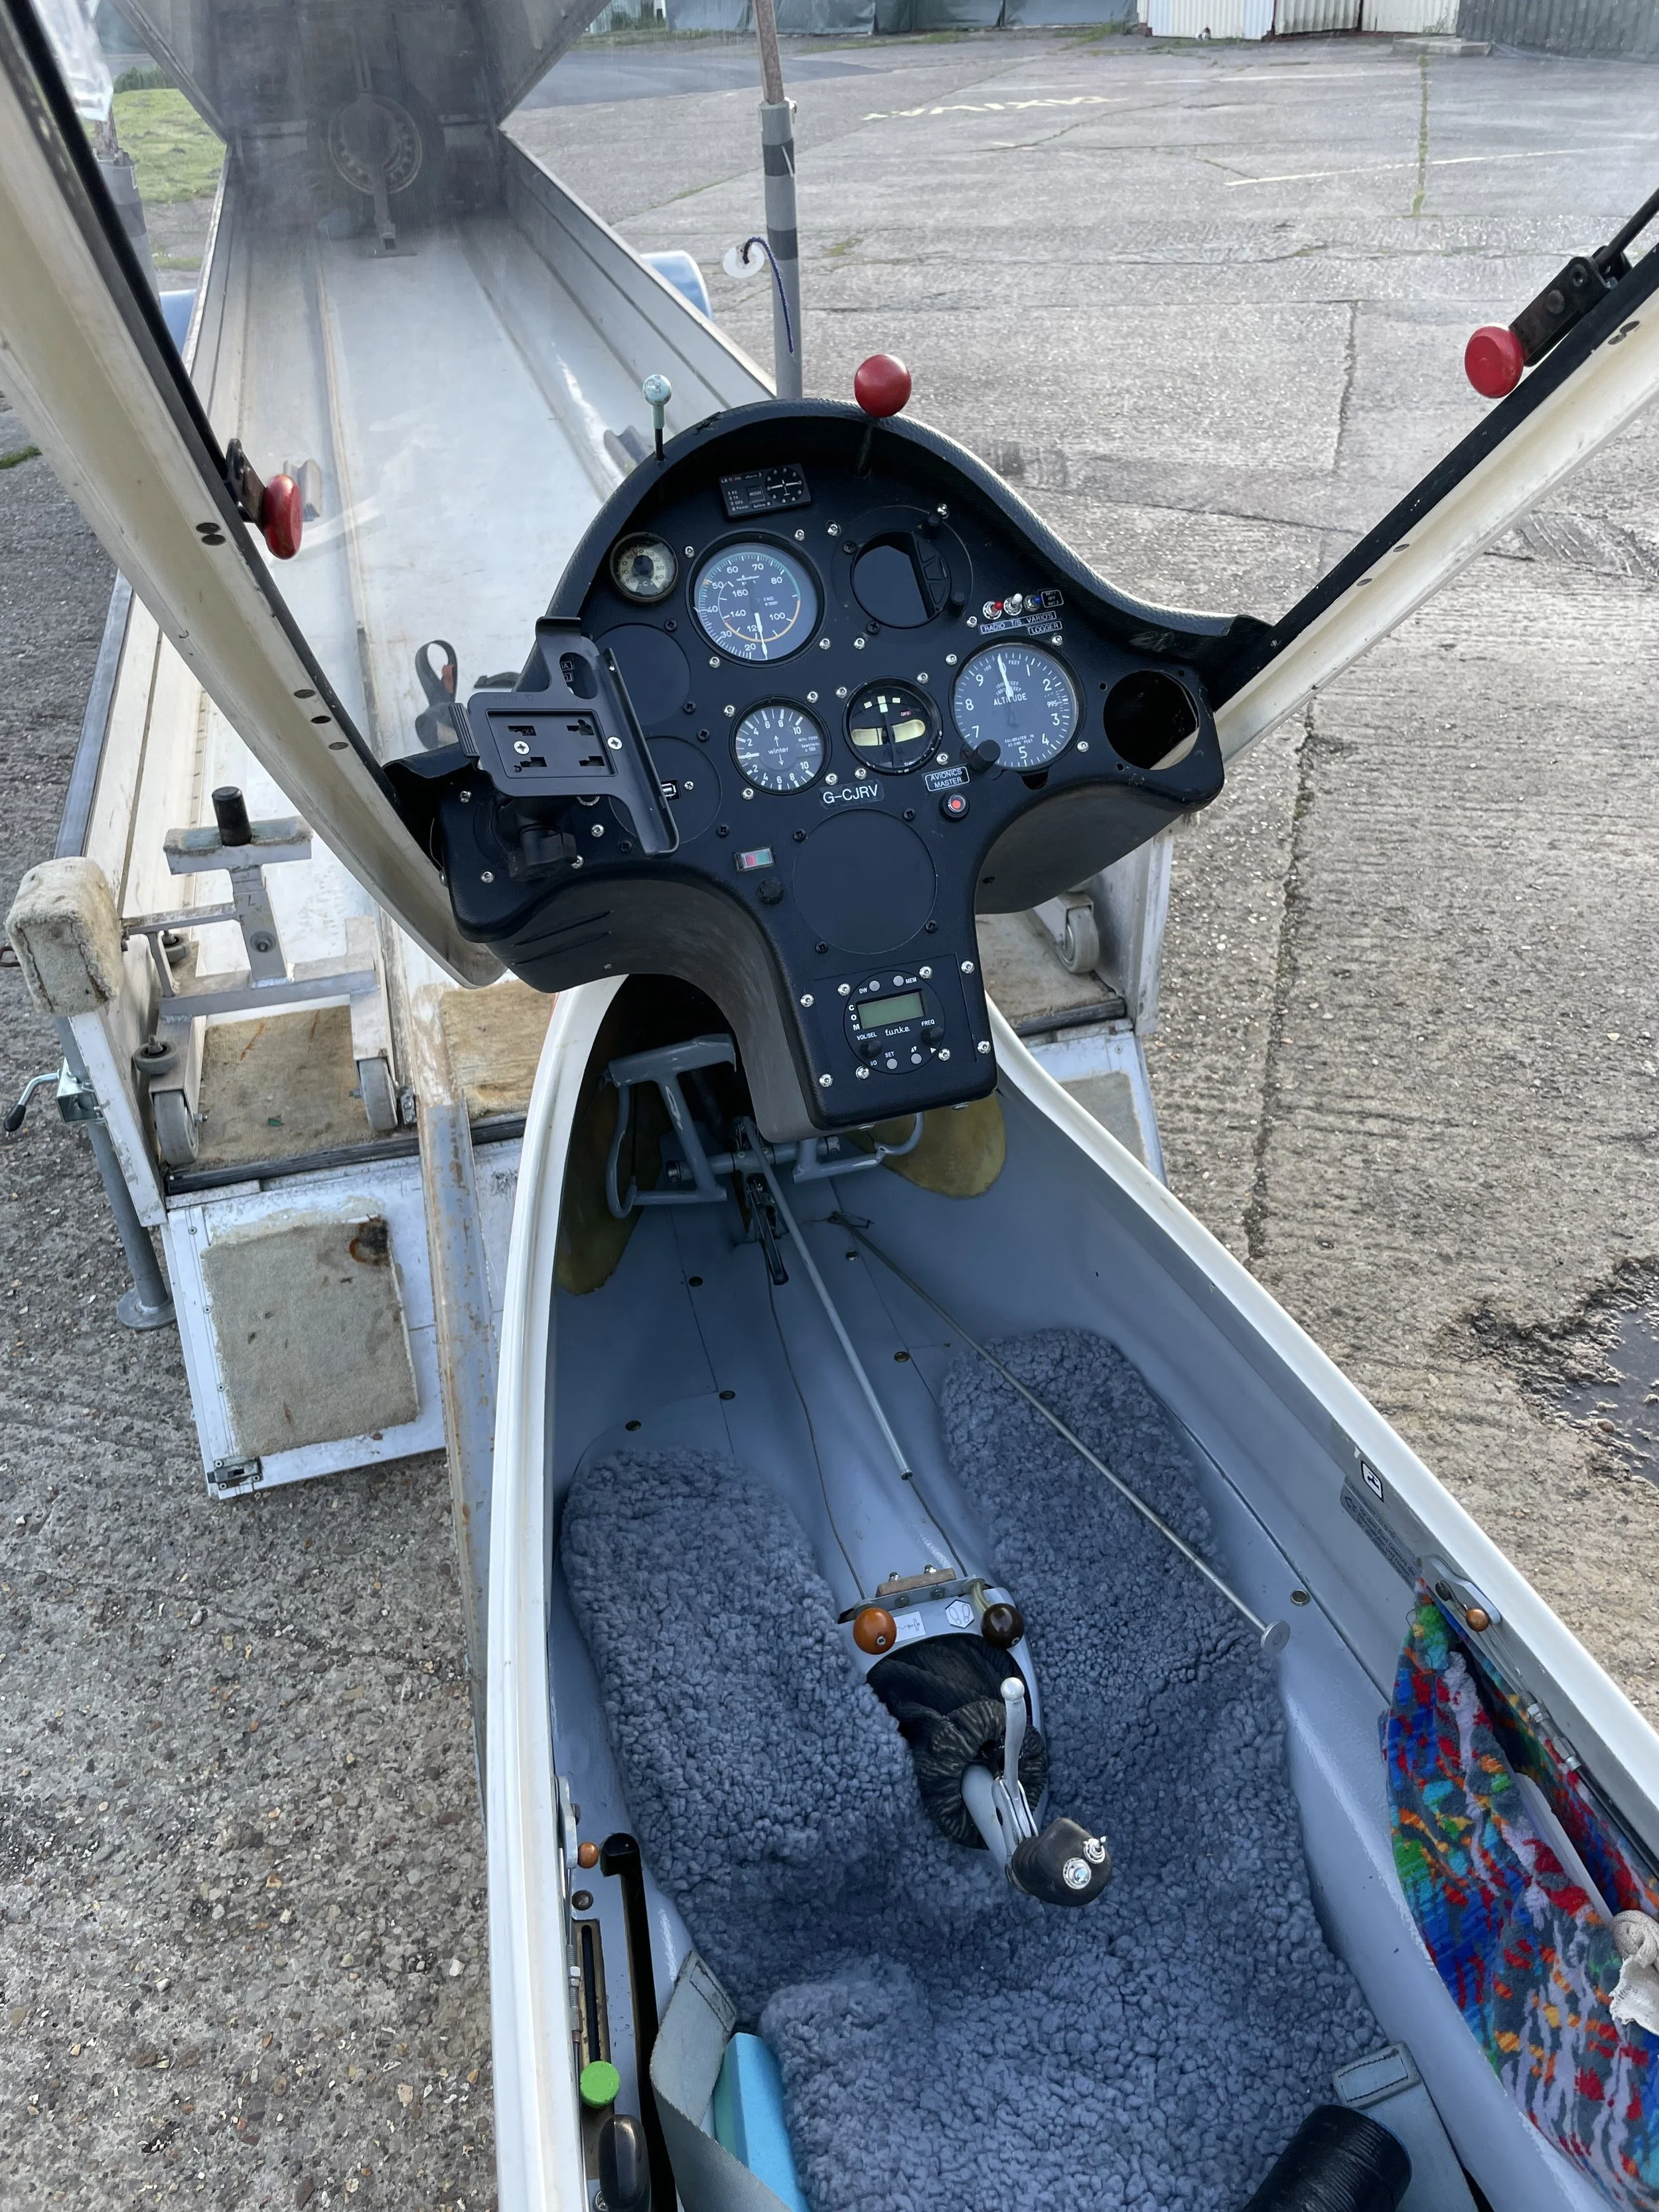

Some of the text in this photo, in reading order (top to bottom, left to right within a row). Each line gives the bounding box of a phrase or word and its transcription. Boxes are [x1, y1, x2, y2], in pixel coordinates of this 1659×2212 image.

[733, 589, 749, 597] 160
[984, 623, 1005, 632] RADIO
[1026, 613, 1053, 623] VARIO'S
[1031, 623, 1059, 634] LOGGER
[975, 674, 984, 687] 9
[1043, 678, 1052, 692] 2
[965, 699, 974, 711] 8
[778, 719, 784, 728] 8
[1050, 713, 1060, 726] 3
[793, 726, 802, 735] 10
[972, 725, 979, 739] 7
[1042, 733, 1050, 745] 4
[768, 747, 789, 755] winter
[1019, 746, 1027, 759] 5
[800, 761, 809, 770] 10
[789, 773, 795, 781] 8
[930, 768, 962, 781] AVIONICS
[934, 777, 962, 788] MASTER
[823, 784, 878, 804] G-CJRV
[857, 1032, 877, 1041] VOL/SEL
